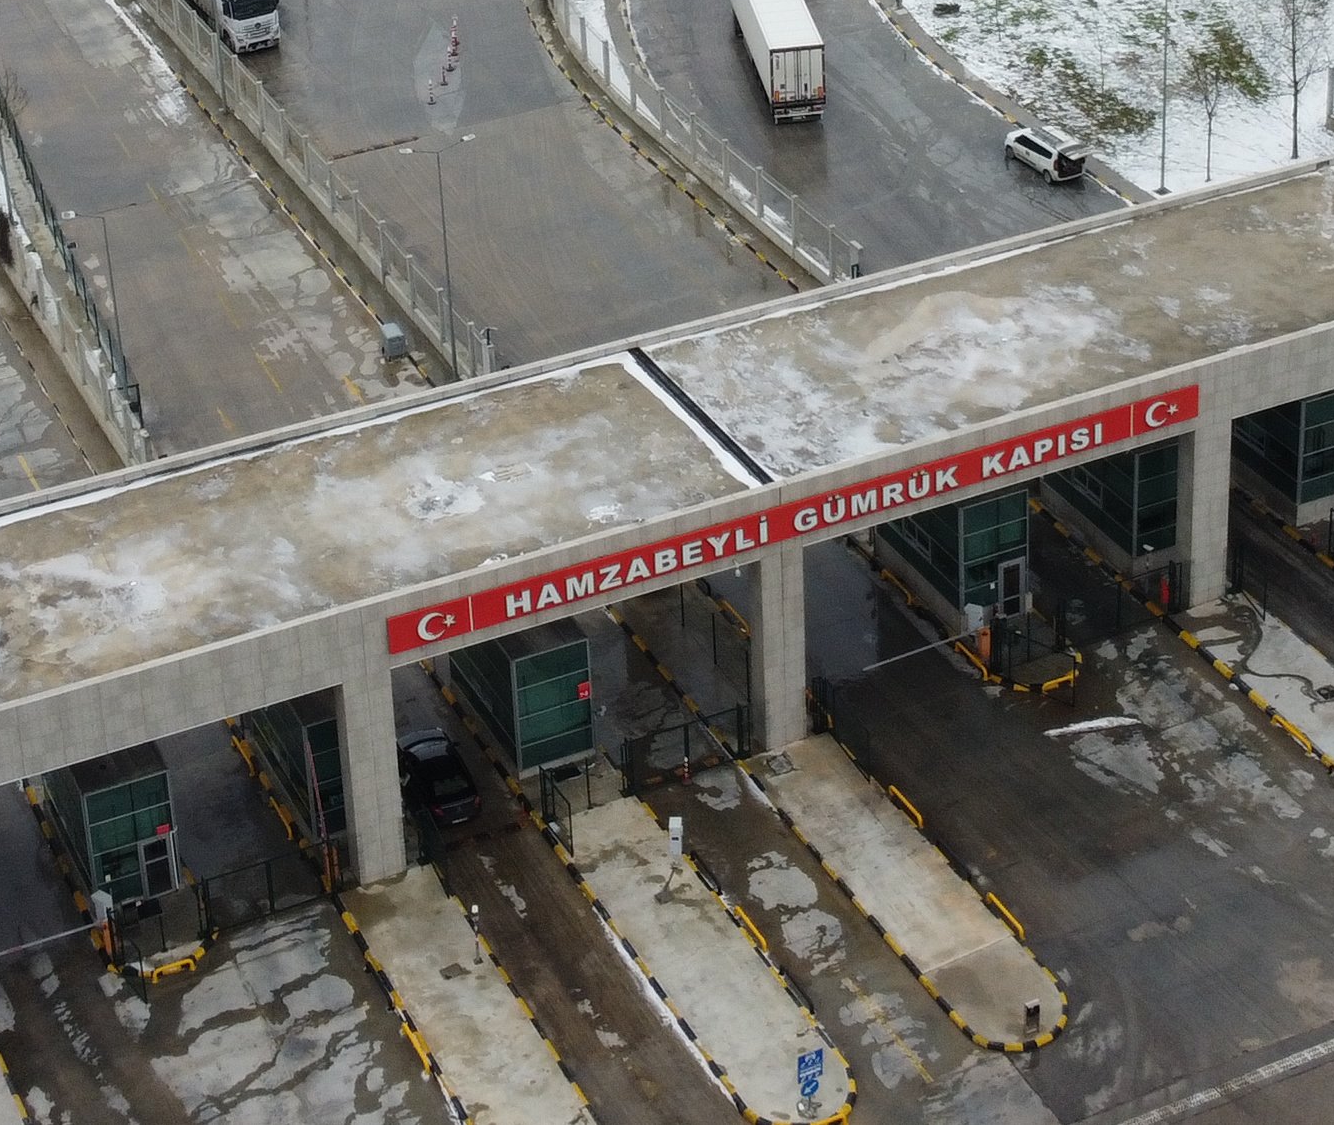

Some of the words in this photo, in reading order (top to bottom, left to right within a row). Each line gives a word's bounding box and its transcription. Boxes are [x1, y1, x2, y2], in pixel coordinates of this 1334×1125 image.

[505, 515, 769, 618] HAMZABEYLİ
[793, 464, 960, 532] GÜMRÜK
[981, 423, 1104, 478] KAPISI
